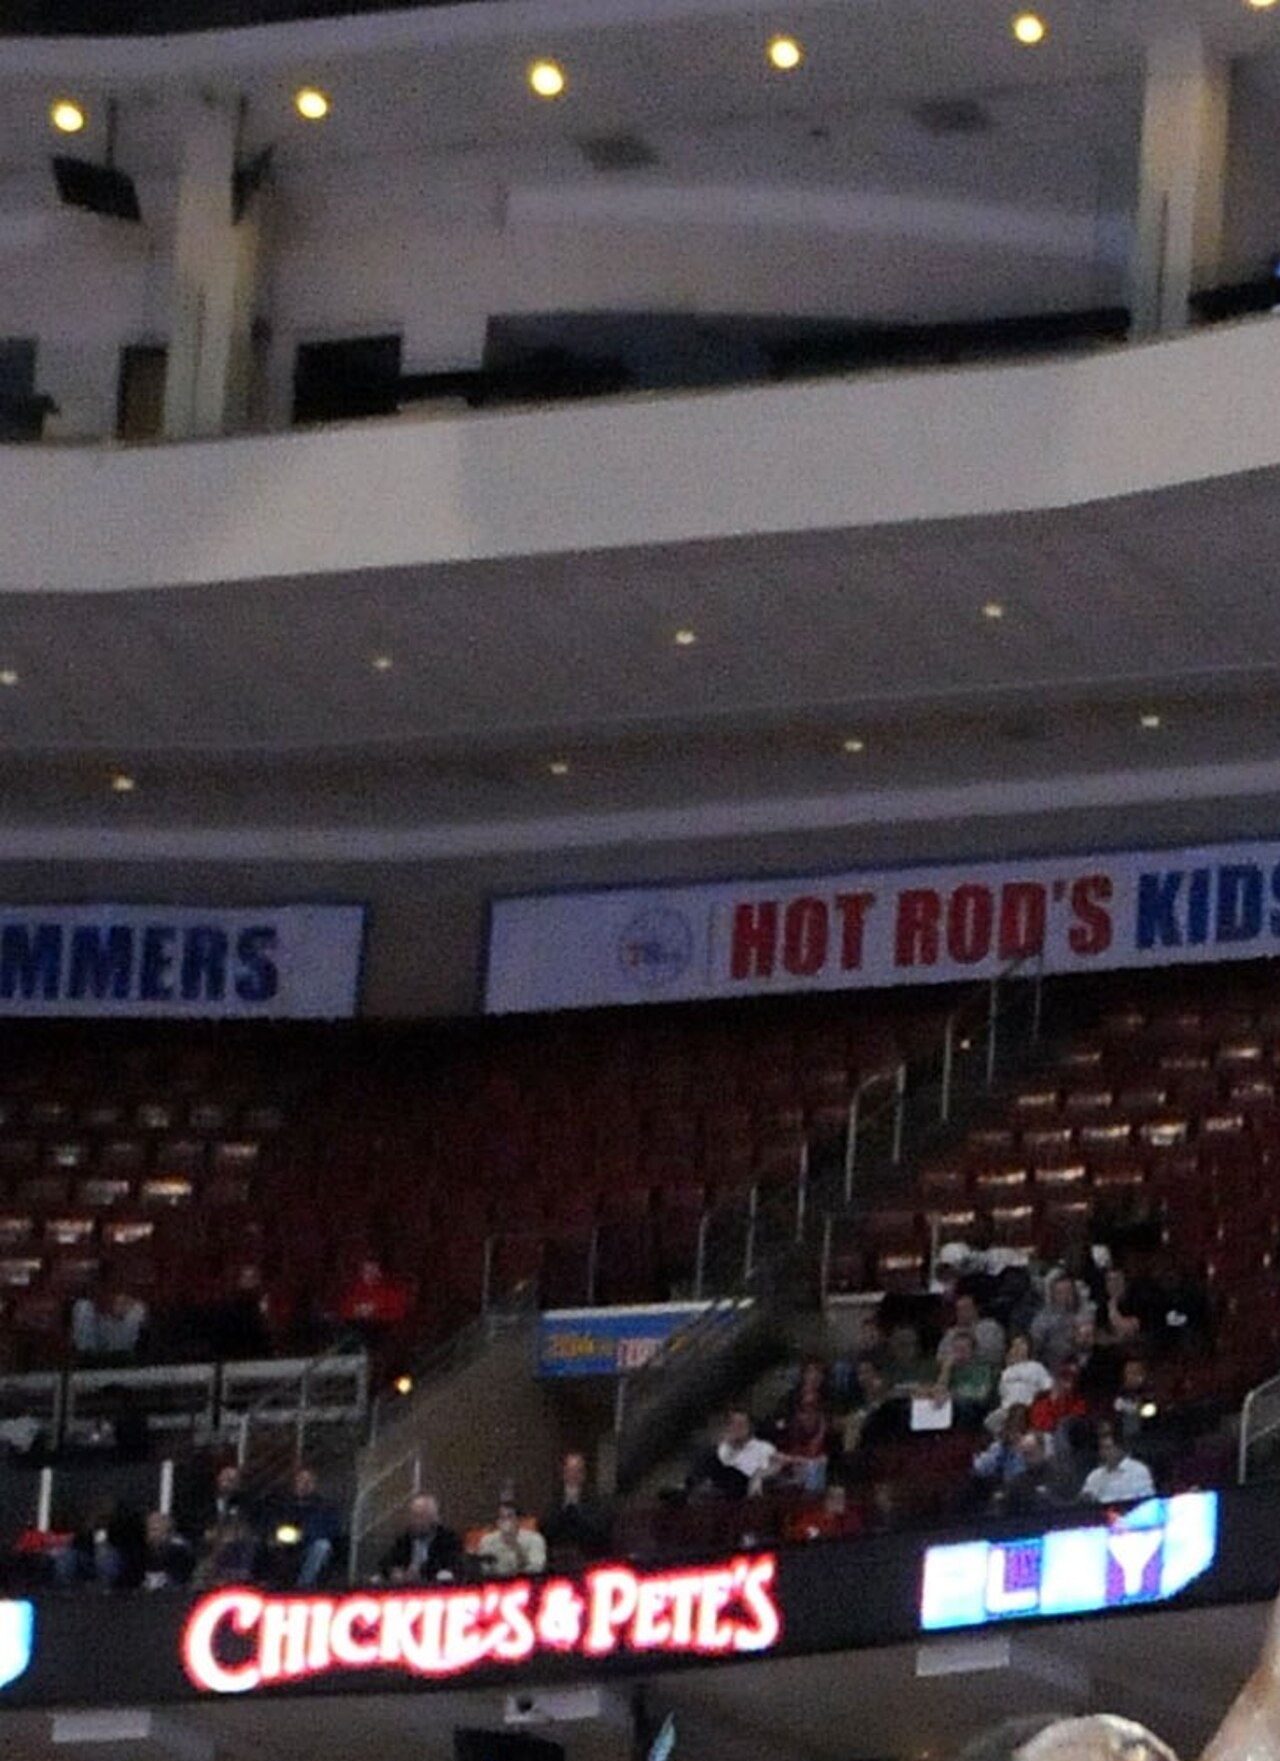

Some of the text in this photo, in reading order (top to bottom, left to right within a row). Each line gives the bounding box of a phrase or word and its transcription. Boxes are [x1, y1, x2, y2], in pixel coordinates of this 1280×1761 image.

[730, 892, 873, 980] HOT
[895, 874, 1114, 967] ROD'S
[183, 1552, 784, 1694] CHICKIE'S & PETE'S
